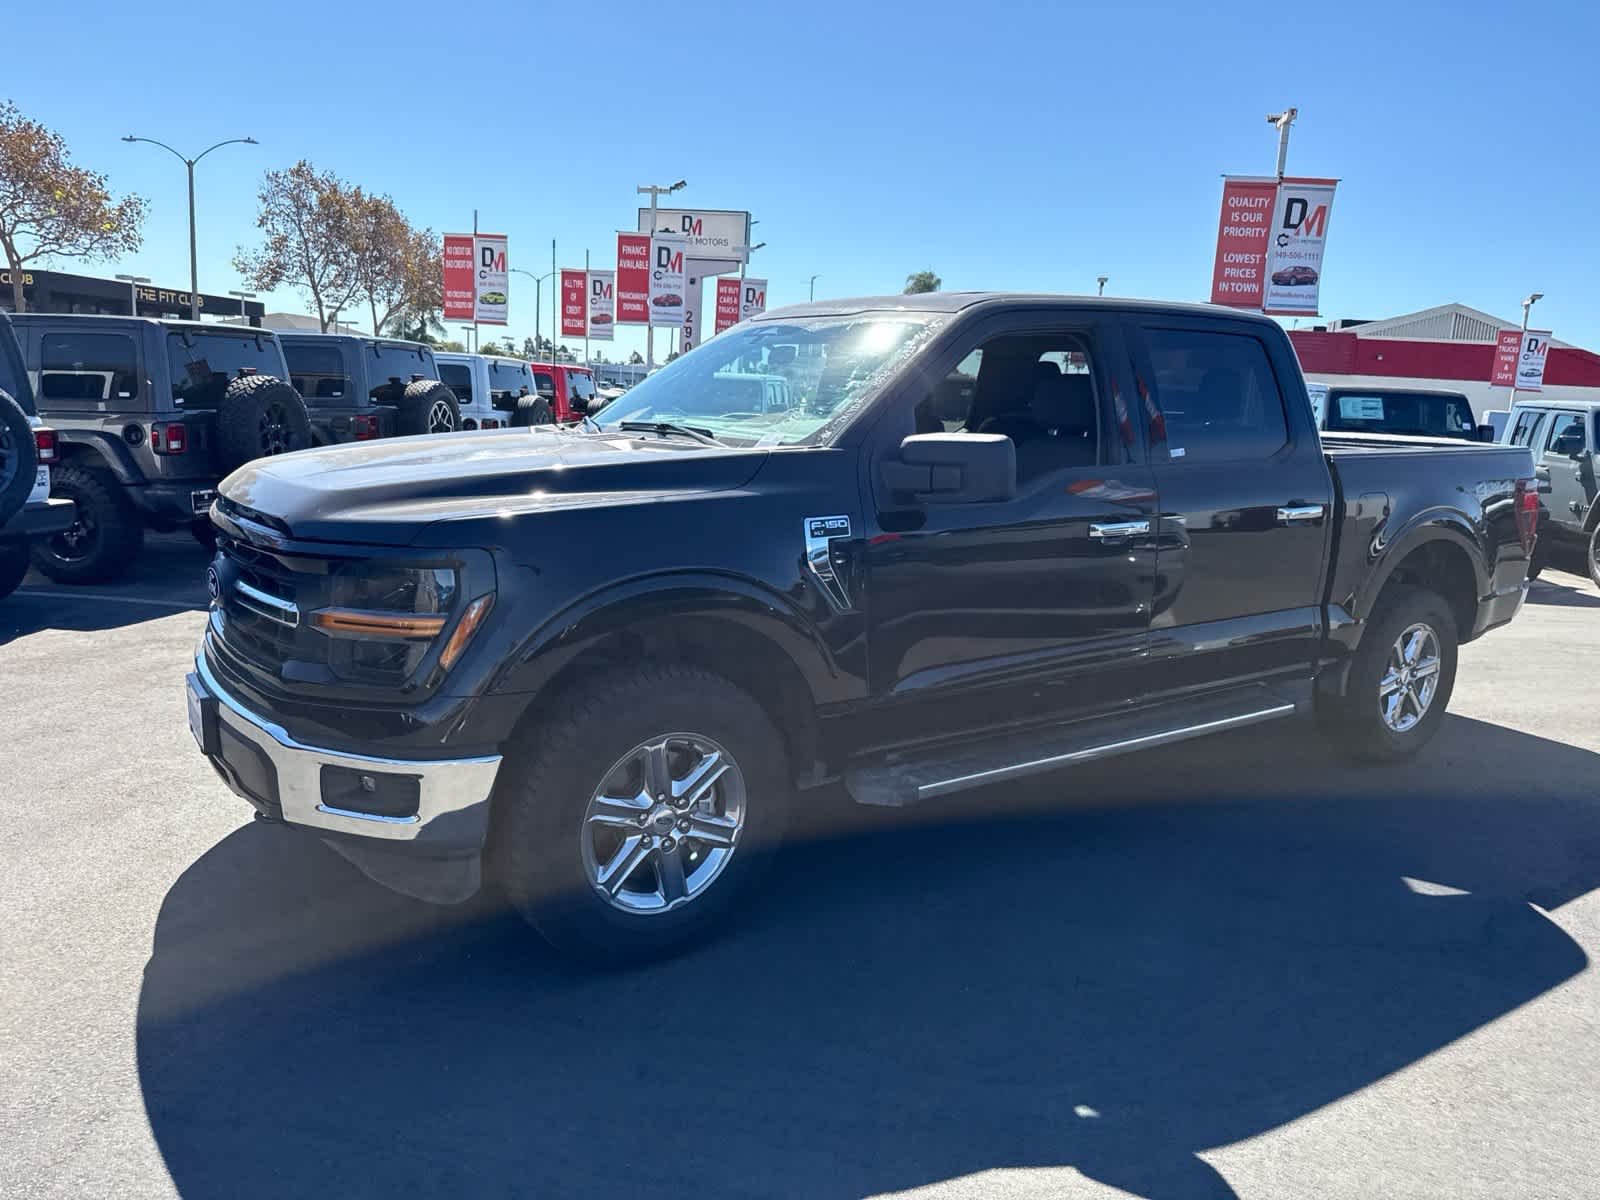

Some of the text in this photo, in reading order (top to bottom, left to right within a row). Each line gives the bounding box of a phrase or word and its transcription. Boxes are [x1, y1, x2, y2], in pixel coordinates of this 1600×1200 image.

[1228, 196, 1270, 208] QUALITY
[1231, 211, 1263, 222] IS OUR
[1223, 227, 1267, 237] PRIORITY
[695, 237, 728, 247] MOTORS
[622, 245, 646, 256] FINANCE
[618, 258, 648, 269] AVAILABLE
[1223, 253, 1261, 264] LOWEST
[1224, 268, 1256, 278] PRICES
[1219, 283, 1259, 293] IN TOWN
[159, 291, 176, 303] FIT
[178, 293, 204, 307] CLB
[811, 519, 848, 530] F-150
